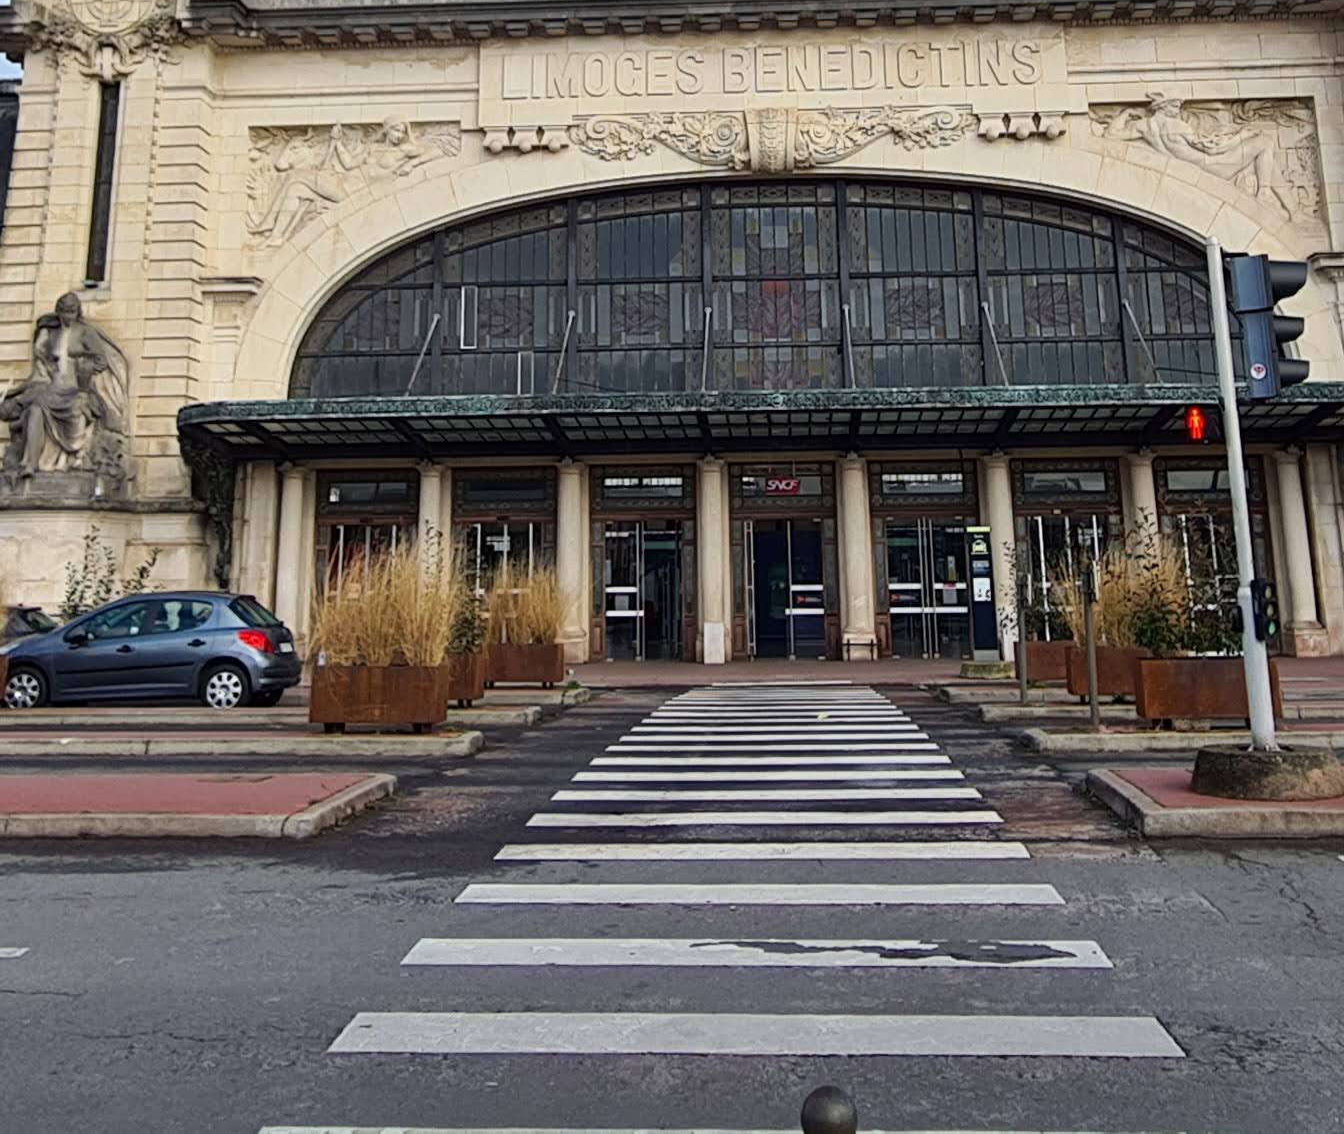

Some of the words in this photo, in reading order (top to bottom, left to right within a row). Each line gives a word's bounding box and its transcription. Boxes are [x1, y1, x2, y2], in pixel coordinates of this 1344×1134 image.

[501, 49, 705, 100] LIMOGES
[721, 39, 1042, 94] BENEDICTINS
[766, 479, 799, 491] SNCF
